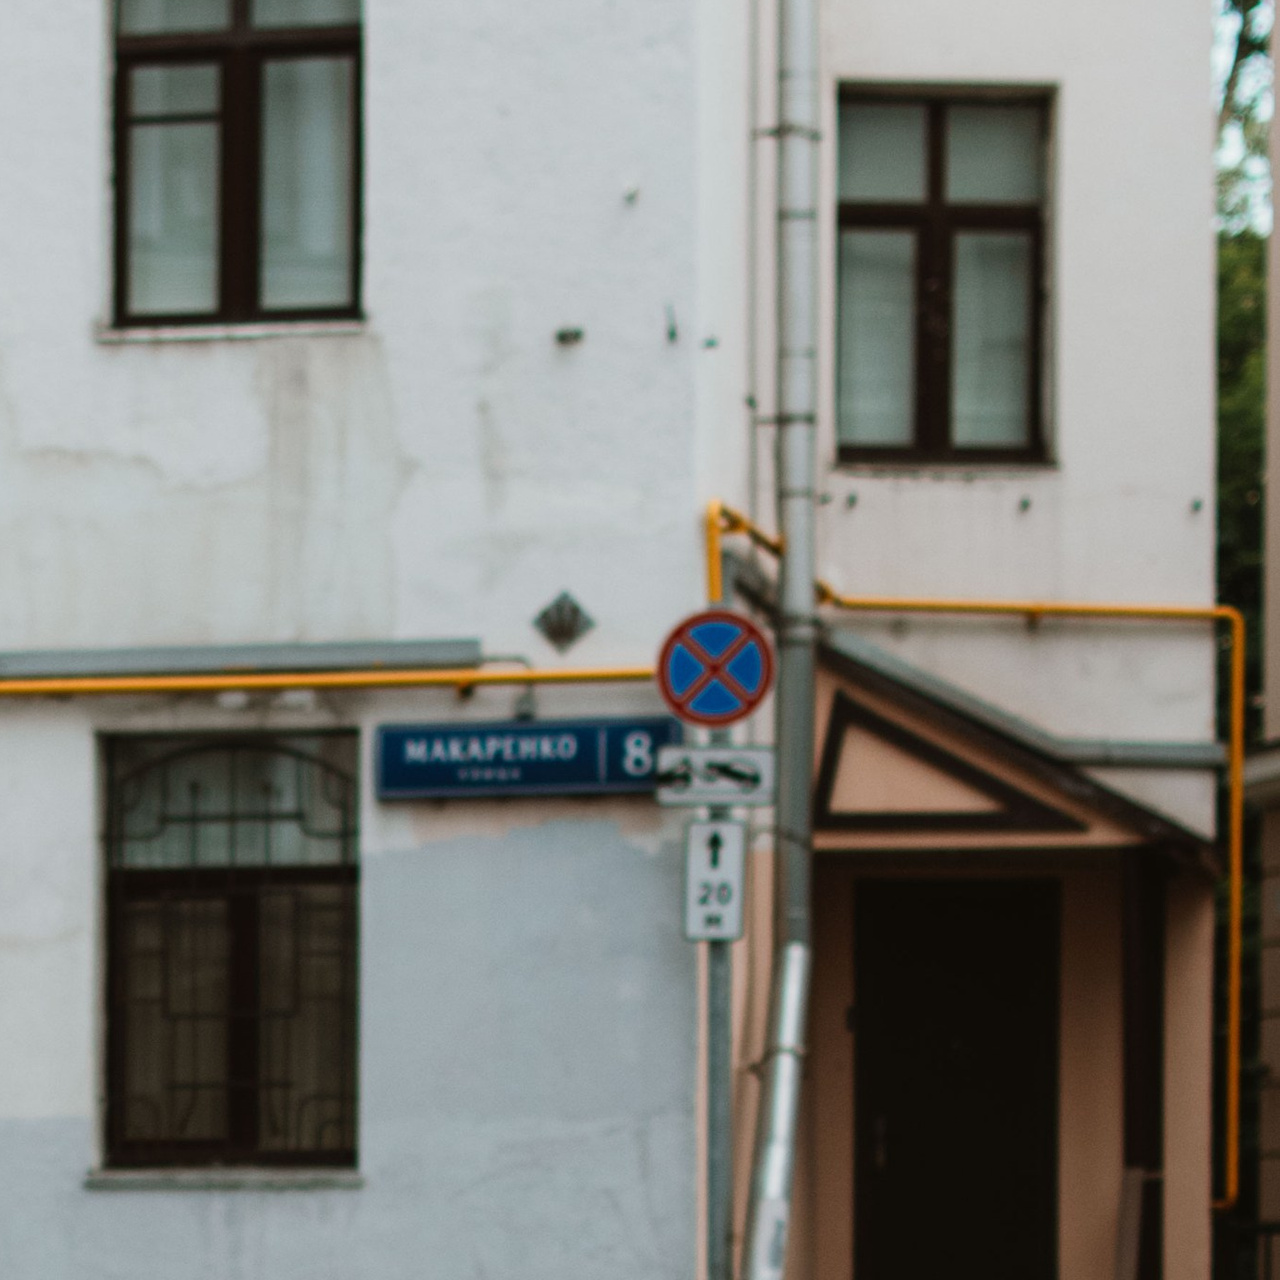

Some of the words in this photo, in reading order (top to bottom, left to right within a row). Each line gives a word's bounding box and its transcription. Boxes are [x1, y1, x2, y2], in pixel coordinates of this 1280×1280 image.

[404, 735, 578, 763] МАКАРЕНКО
[624, 731, 653, 776] 8
[699, 881, 732, 905] 20
